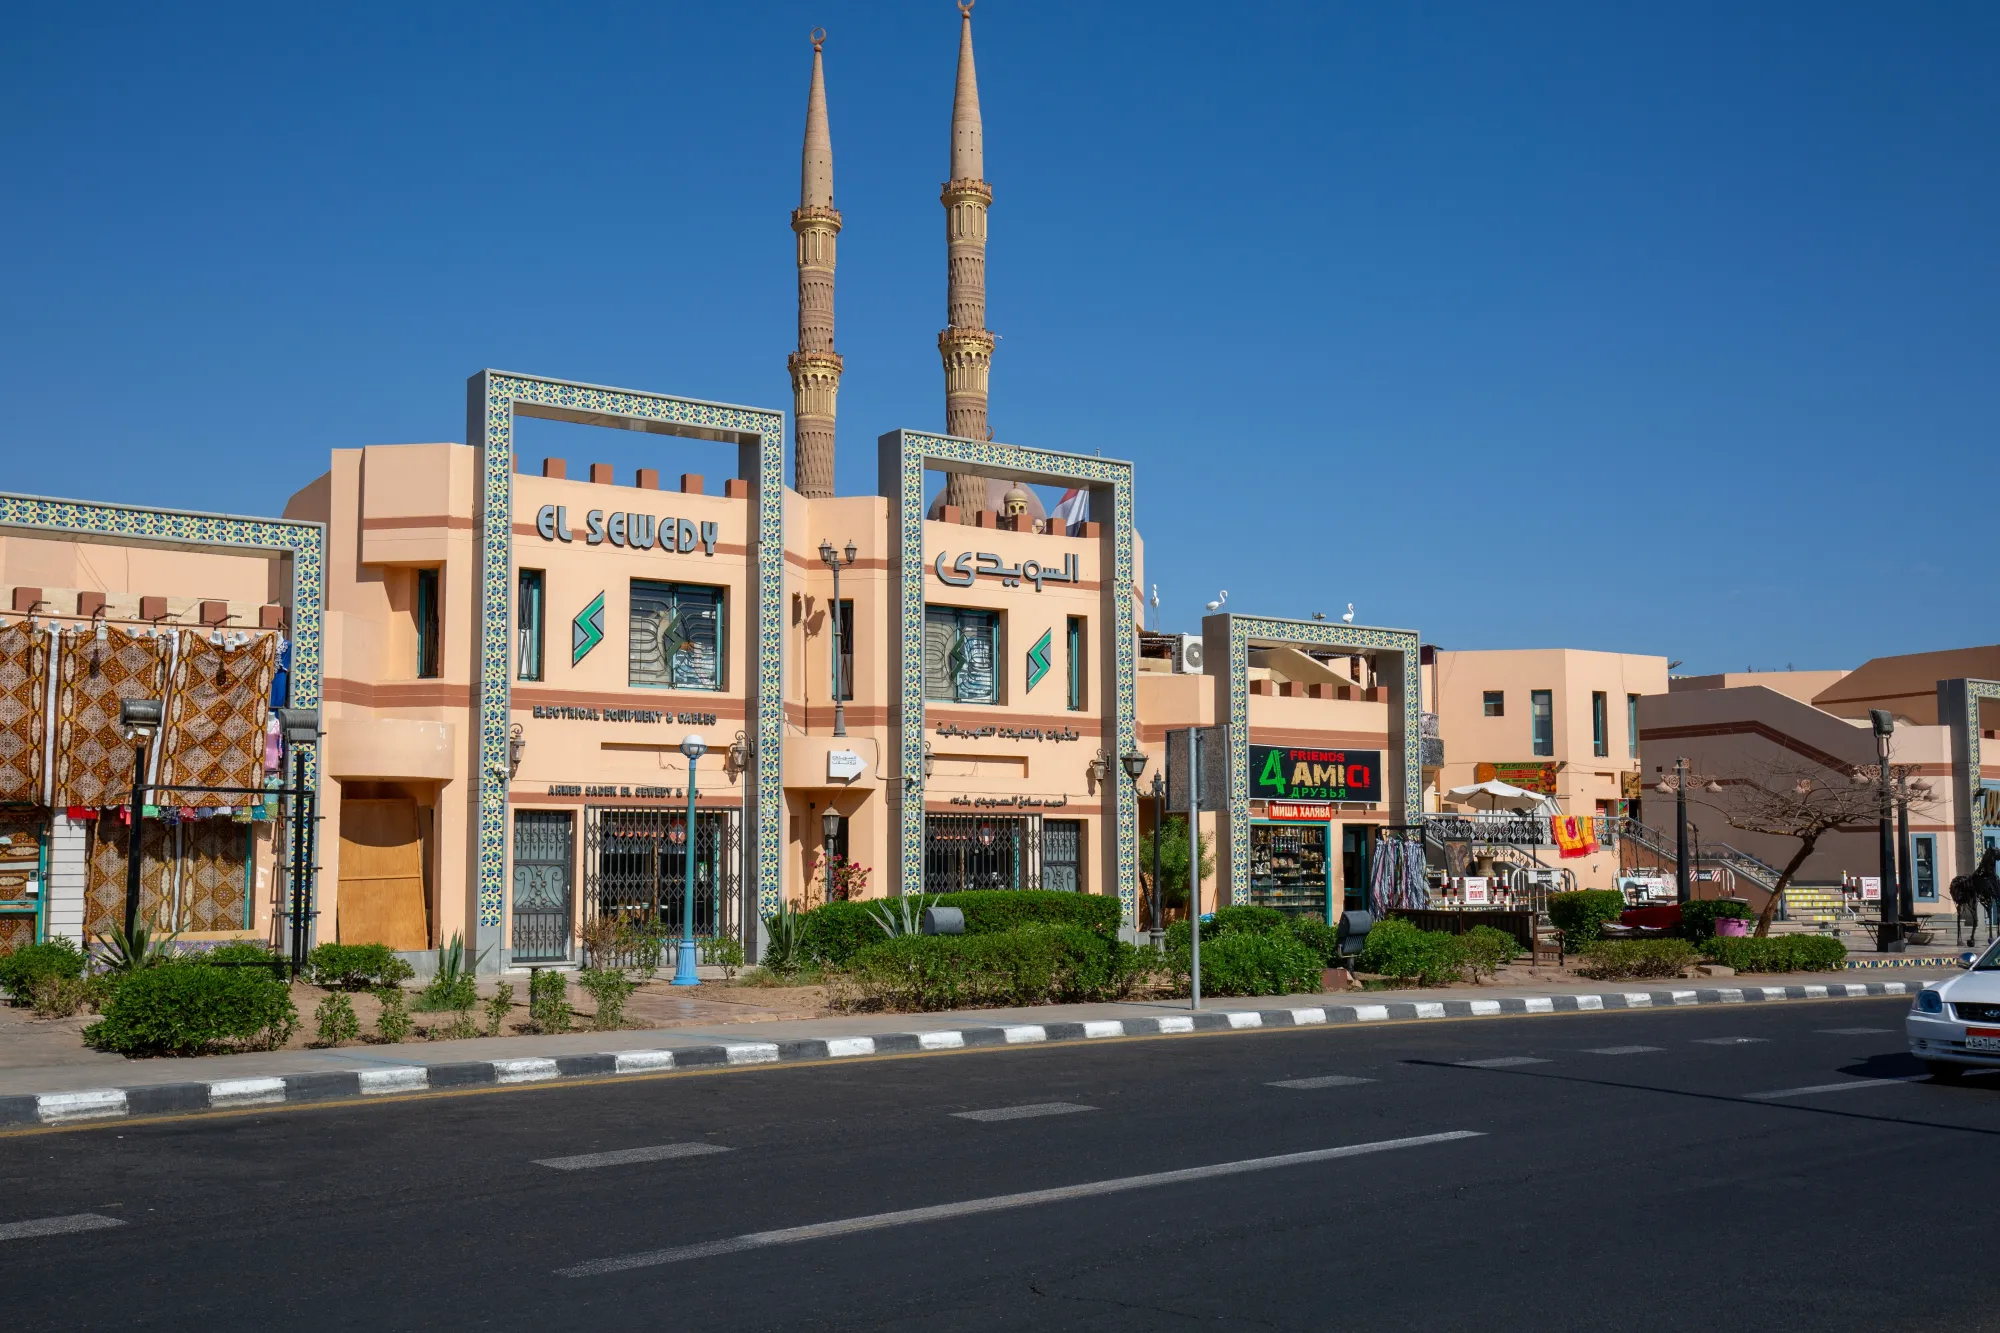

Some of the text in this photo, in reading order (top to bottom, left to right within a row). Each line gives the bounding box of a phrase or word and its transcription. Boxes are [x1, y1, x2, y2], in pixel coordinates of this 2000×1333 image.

[536, 504, 719, 557] EL SEWEDY
[532, 705, 717, 726] ELECTRICAL EQUIPMENT & CABLES
[1289, 750, 1345, 762] FRIENDS
[1259, 749, 1287, 795] 4
[1291, 761, 1371, 788] AMICI
[547, 784, 582, 797] AHMED
[585, 785, 617, 797] SADEK
[620, 785, 632, 798] EL
[635, 786, 673, 798] SEWEDY
[676, 787, 683, 798] &
[1291, 787, 1346, 799] ДРУЗЬЯ
[1271, 804, 1331, 819] МИША ХАЛЯВА
